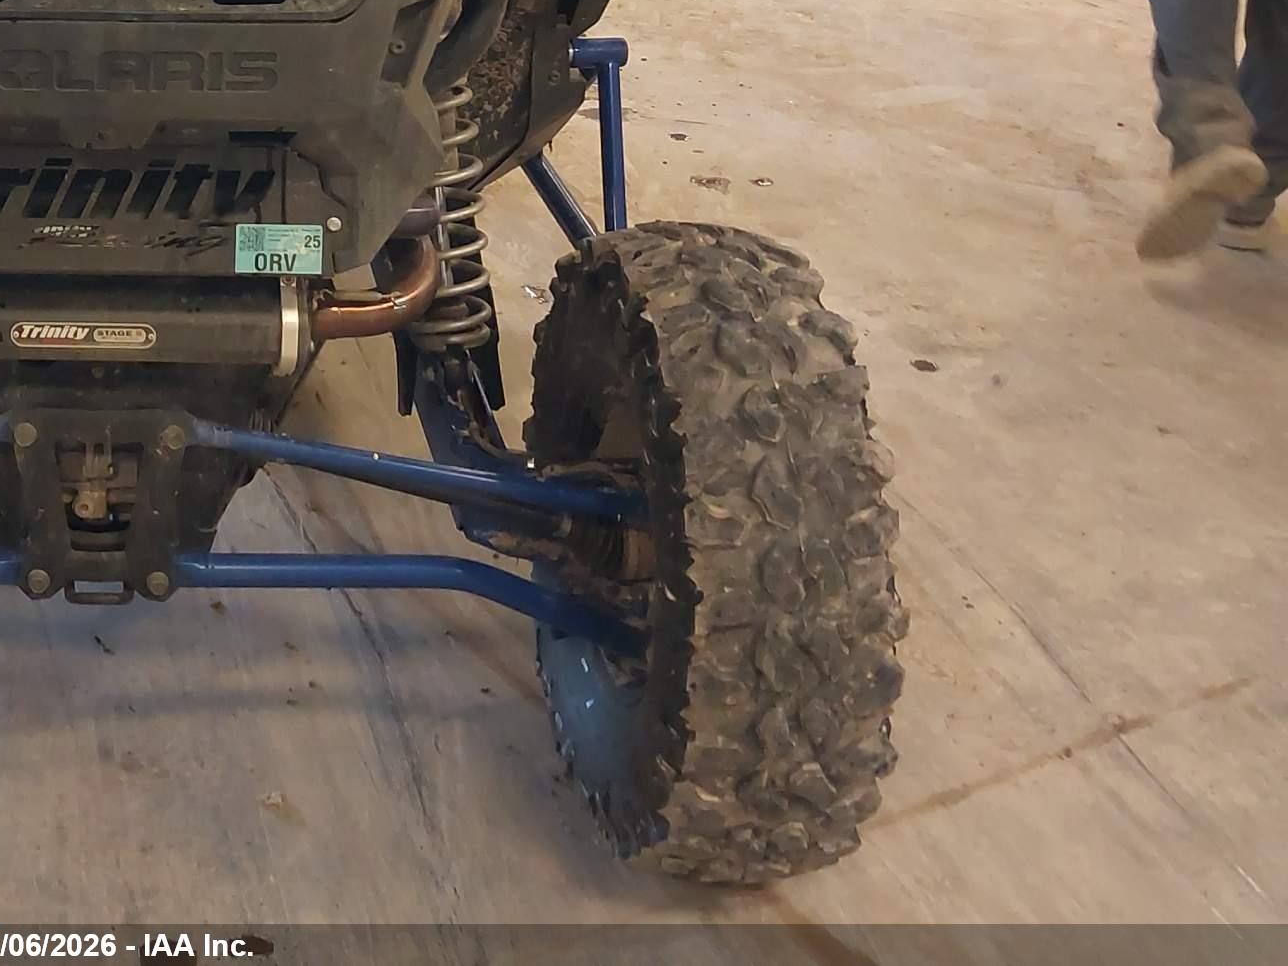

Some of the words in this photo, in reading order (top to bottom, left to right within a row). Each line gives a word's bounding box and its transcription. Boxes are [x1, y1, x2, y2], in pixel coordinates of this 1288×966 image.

[304, 234, 321, 249] 25
[254, 252, 297, 272] ORV
[20, 324, 90, 340] Trinity
[98, 329, 132, 337] STAGE
